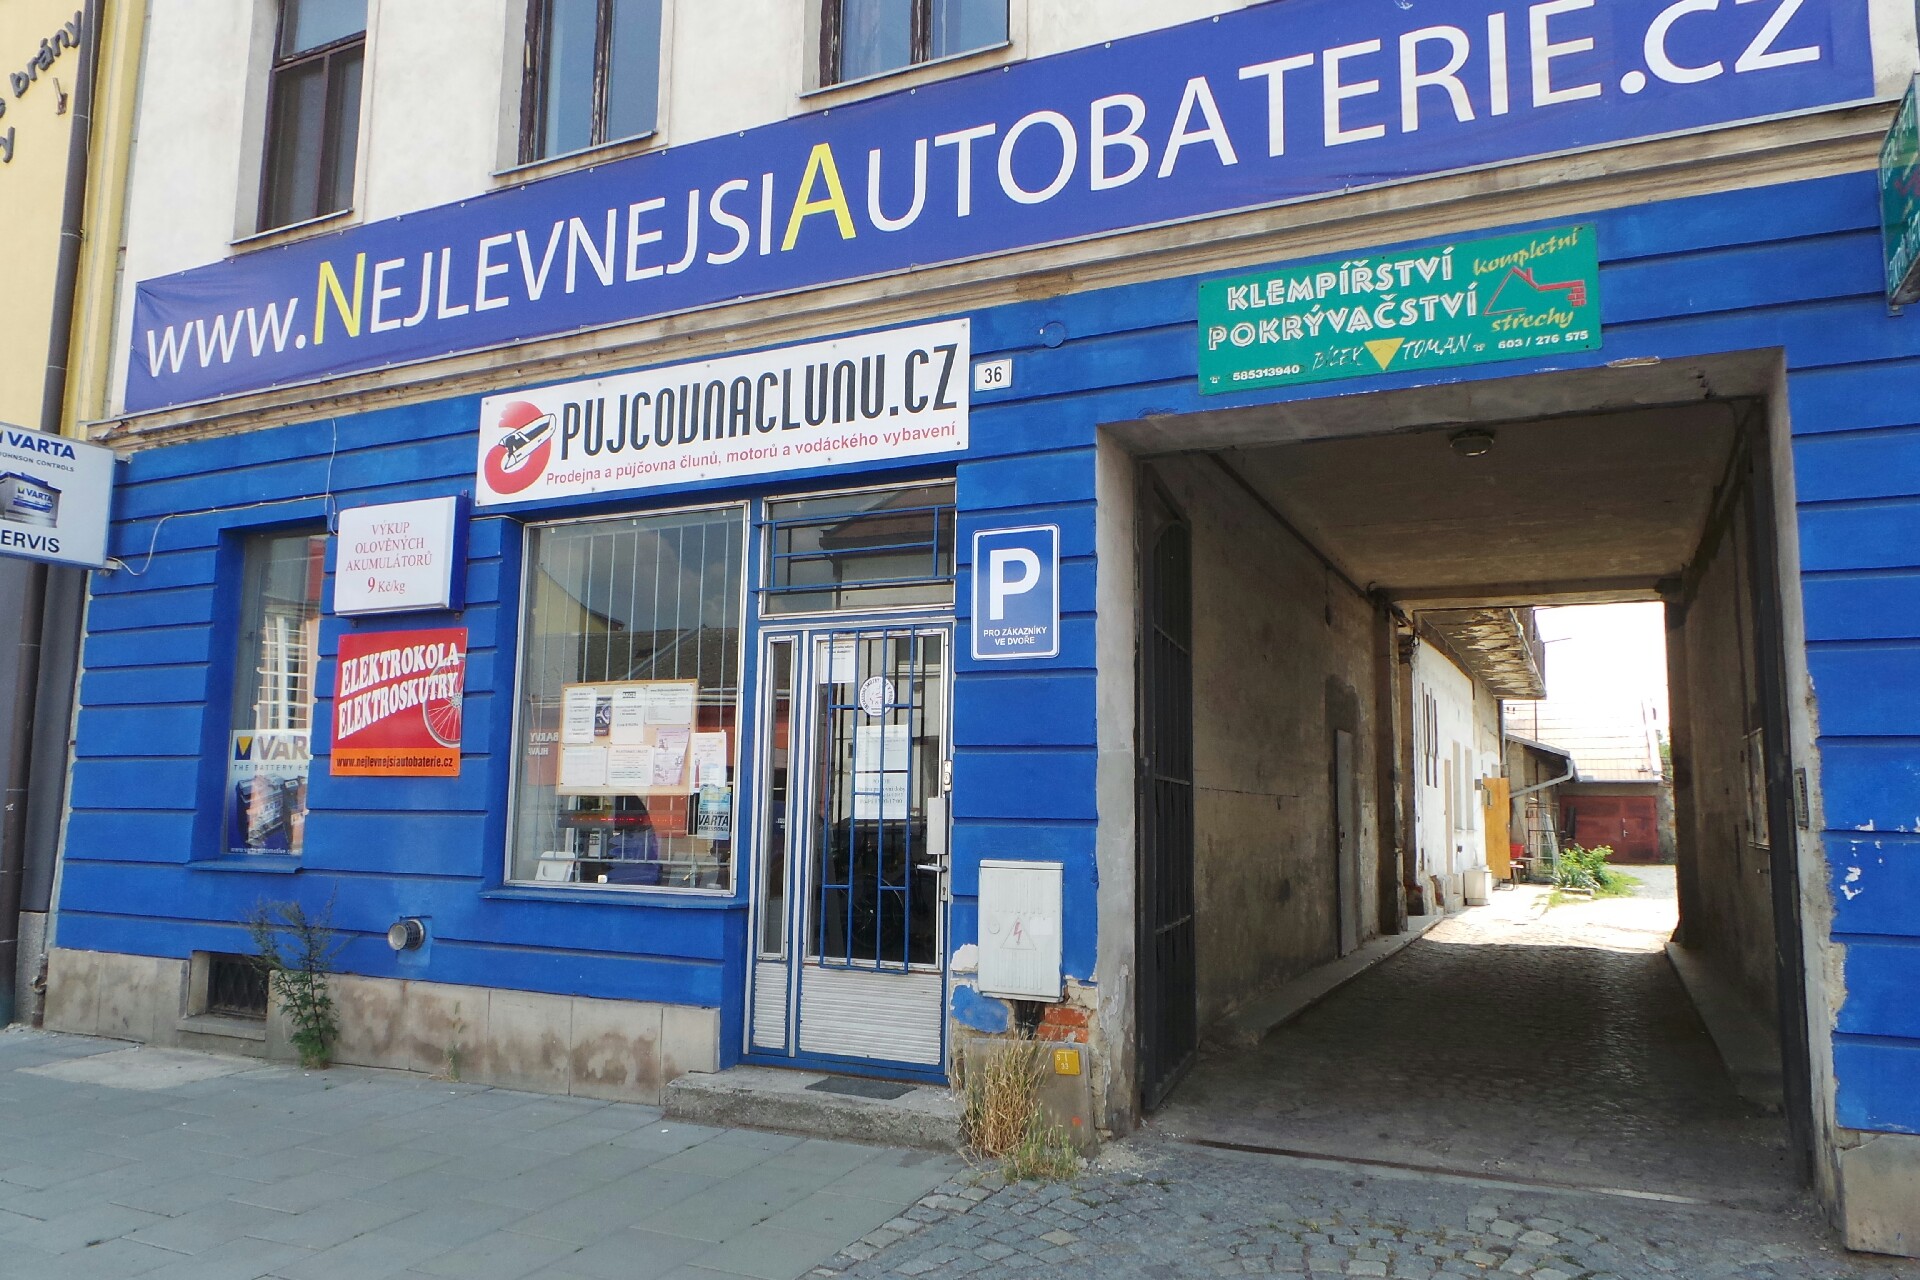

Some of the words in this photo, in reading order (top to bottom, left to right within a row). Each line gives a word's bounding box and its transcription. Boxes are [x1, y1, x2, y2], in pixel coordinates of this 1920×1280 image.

[1473, 228, 1579, 276] kompletní
[1227, 246, 1455, 311] KLEMPÍŘSTVÍ
[1208, 282, 1478, 351] POKRÝVAČSTVÍ
[1491, 307, 1575, 333] střechy
[1402, 333, 1472, 360] TOMAN
[1498, 339, 1523, 349] 603
[1535, 335, 1560, 346] 276
[1564, 330, 1589, 341] 575
[984, 366, 1002, 384] 36
[1232, 364, 1300, 381] 585313940
[561, 343, 958, 461] PUJCOVNACLUNU.CZ
[7, 431, 76, 460] VARTA
[546, 468, 601, 486] Prodejna
[604, 470, 612, 478] a
[616, 458, 676, 480] půjčovna
[680, 450, 722, 469] člunů,
[727, 443, 778, 463] motorů
[782, 446, 791, 456] a
[795, 432, 878, 455] vodáckého
[883, 421, 956, 447] vybavení
[36, 459, 75, 473] CONTROLS
[372, 520, 410, 536] VÝKUP
[355, 535, 424, 554] OLOVĚNÝCH
[345, 551, 433, 572] AKUMULÁTORŮ
[367, 576, 376, 594] 9
[378, 580, 406, 595] Kč/kg
[990, 547, 1041, 621] P
[983, 628, 1001, 637] PRO
[1001, 625, 1048, 636] ZÁKAZNÍKY
[994, 637, 1006, 646] VE
[1007, 635, 1036, 646] DVOŘE
[340, 642, 460, 698] ELEKTROKOLA
[337, 672, 459, 740] ELEKTROSKUTRY
[233, 764, 249, 772] THE
[254, 764, 293, 772] BATTERY
[336, 755, 453, 769] www.nejlevnejsiautobaterie.cz
[698, 814, 729, 827] VARTA
